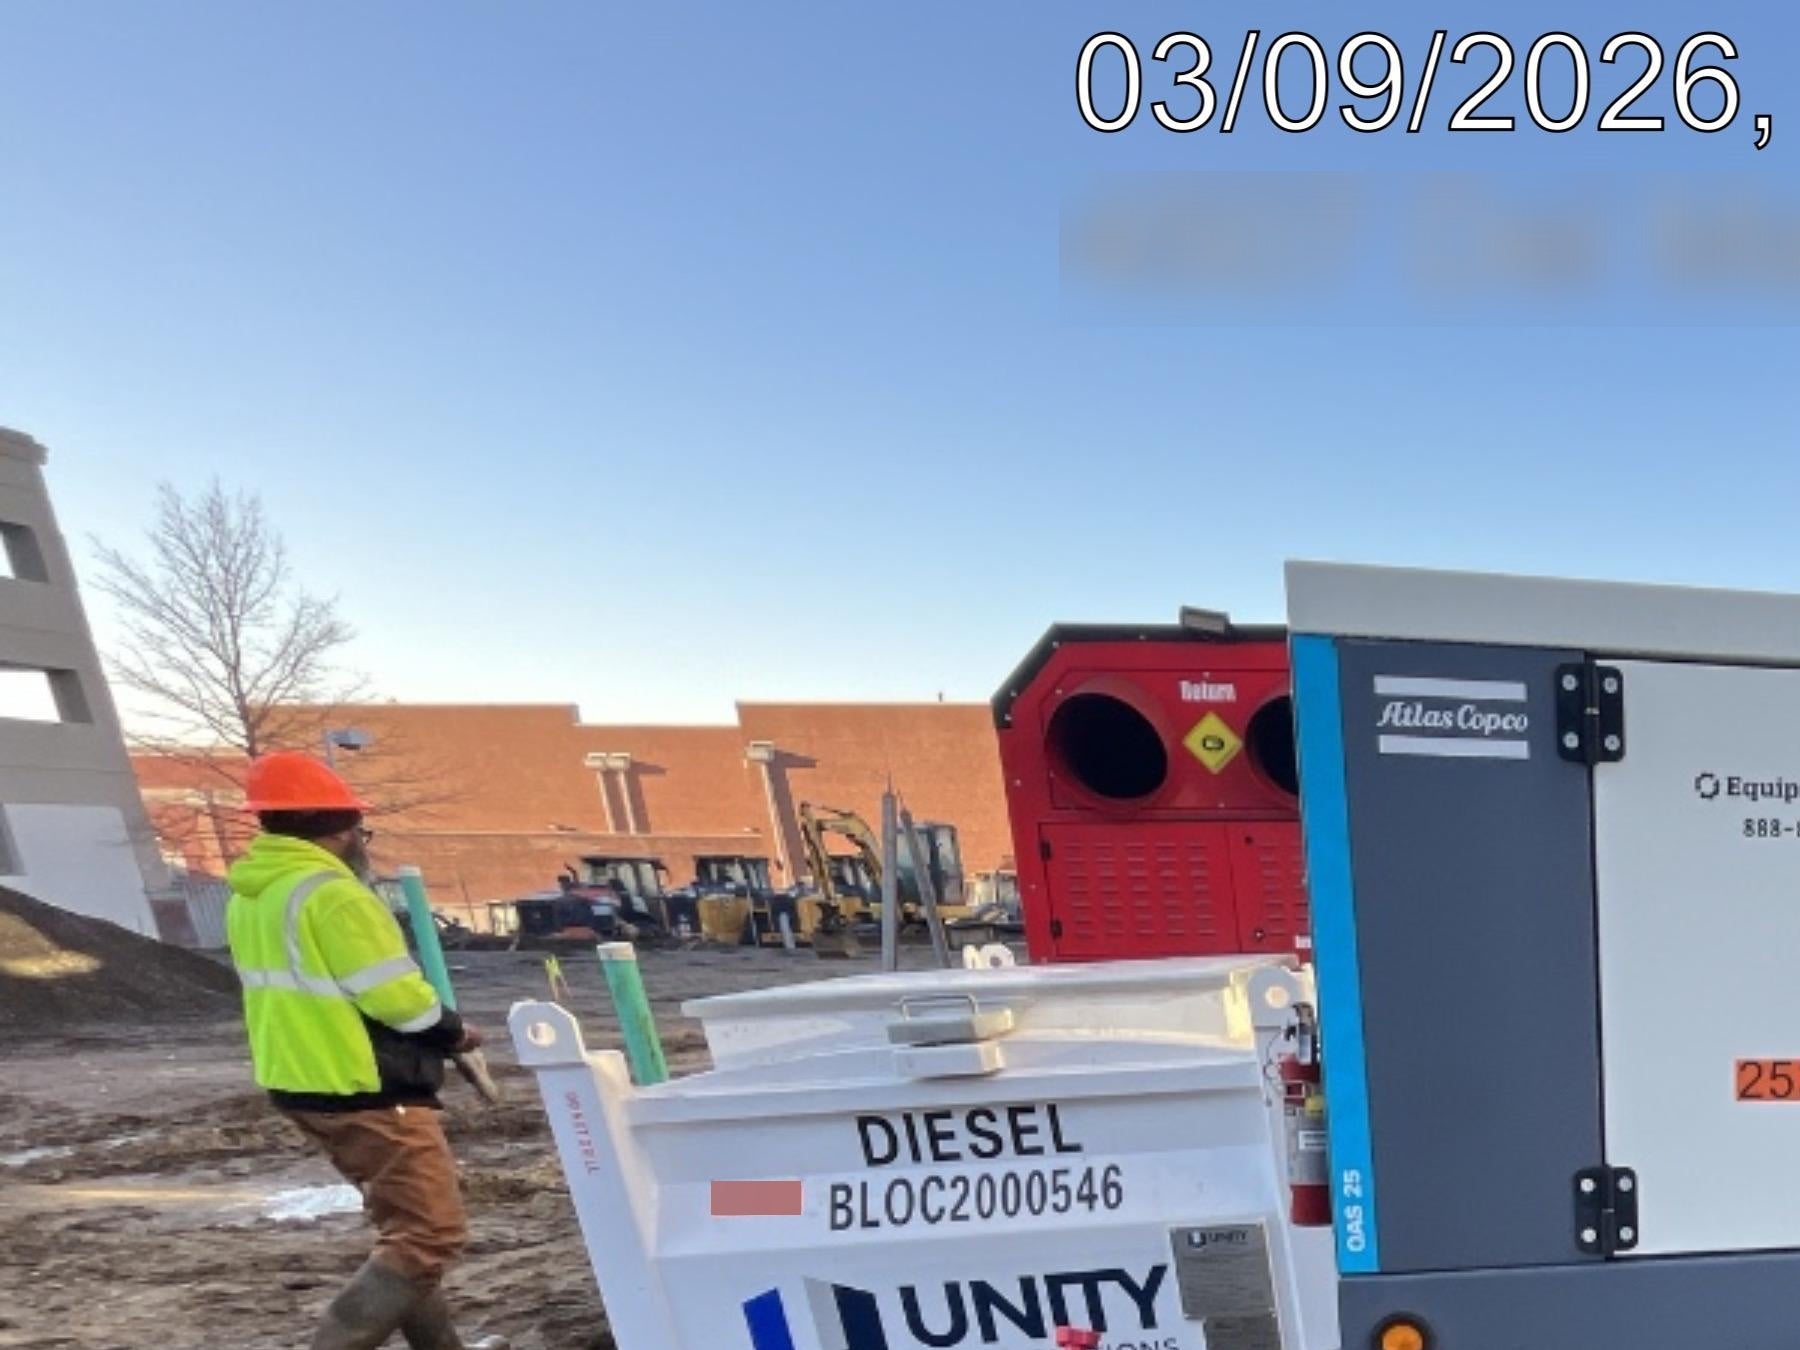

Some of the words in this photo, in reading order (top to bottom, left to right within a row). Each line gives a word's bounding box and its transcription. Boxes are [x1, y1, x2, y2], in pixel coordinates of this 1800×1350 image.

[1376, 702, 1453, 727] Atlas
[1456, 704, 1528, 736] Copco
[855, 1103, 1084, 1168] DIESEL
[829, 1163, 1124, 1231] BLOC2000546
[1343, 1168, 1362, 1198] 25
[897, 1264, 1168, 1348] UNITY
